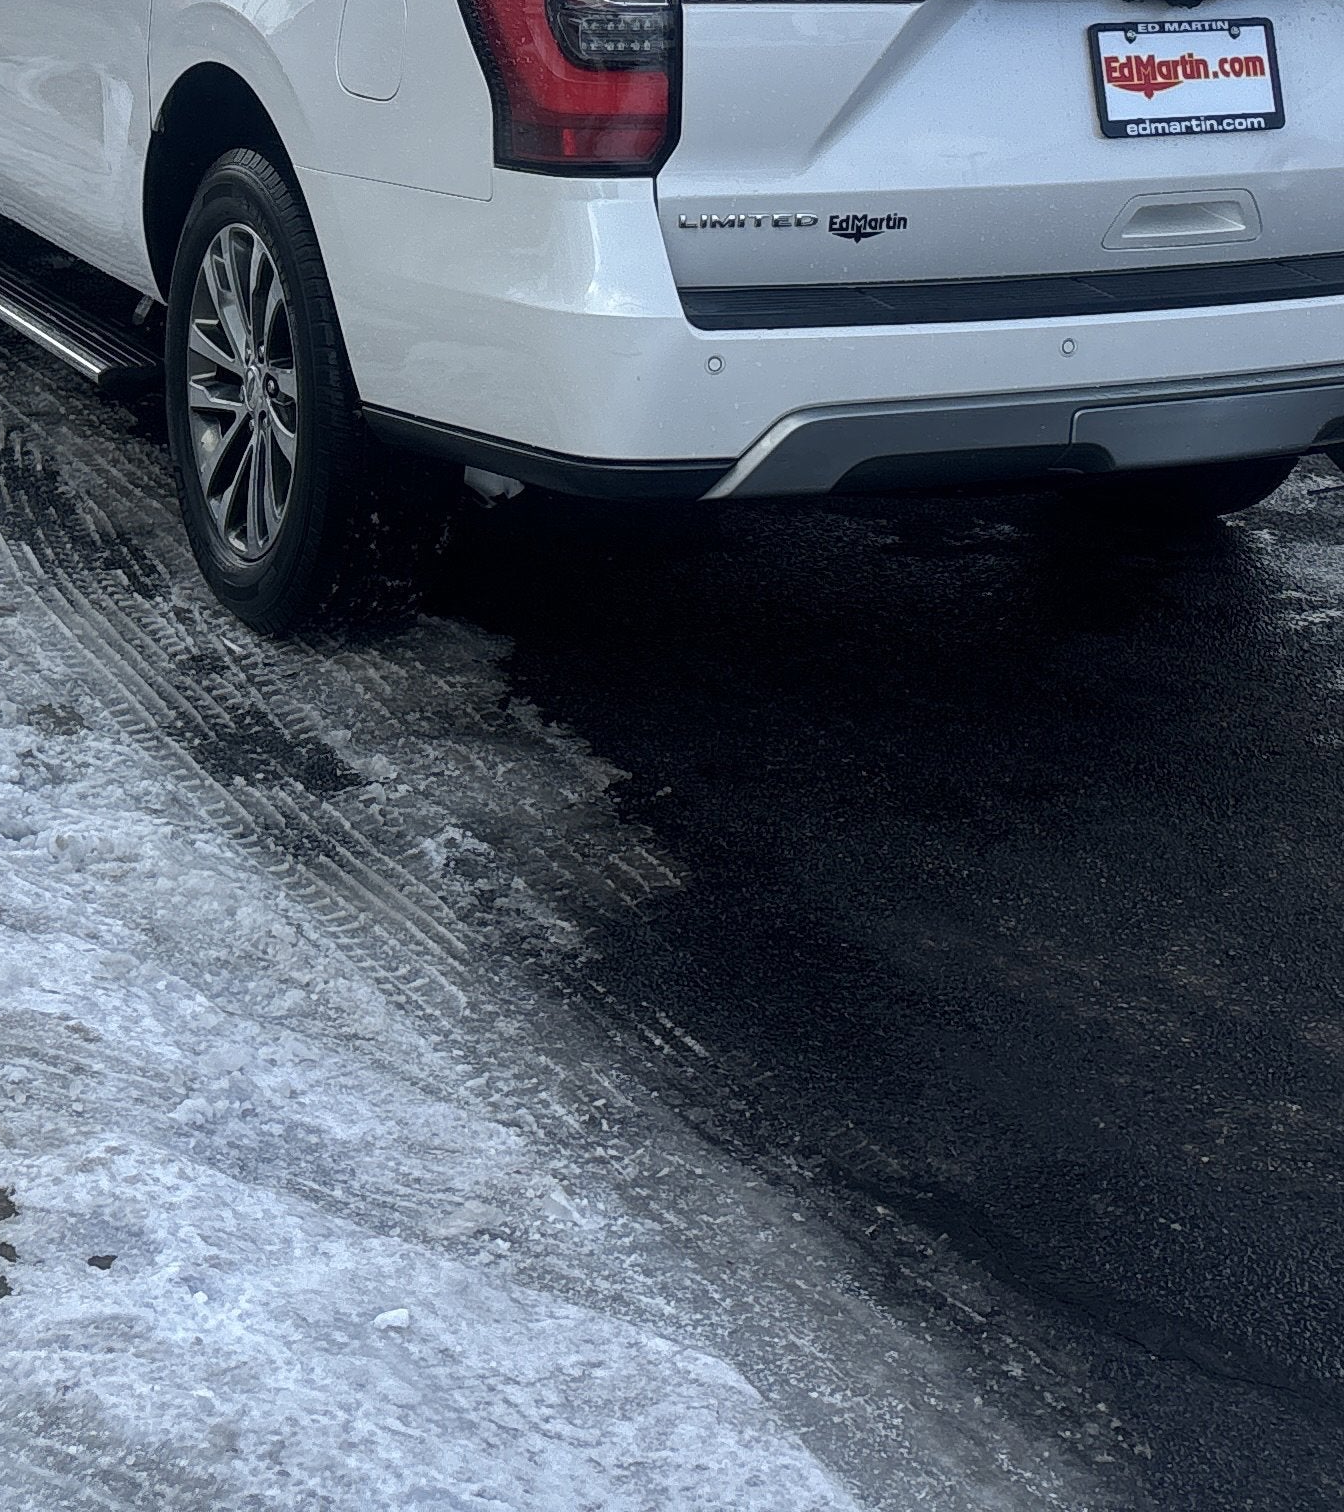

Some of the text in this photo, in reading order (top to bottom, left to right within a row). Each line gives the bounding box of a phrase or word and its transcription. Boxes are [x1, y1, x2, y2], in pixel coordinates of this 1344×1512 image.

[1137, 21, 1229, 33] ED MARTIN
[1104, 53, 1265, 85] EdMartin.com
[1126, 116, 1265, 136] edmartin.com
[678, 213, 819, 229] LIMITED
[828, 213, 907, 234] EdMartin
